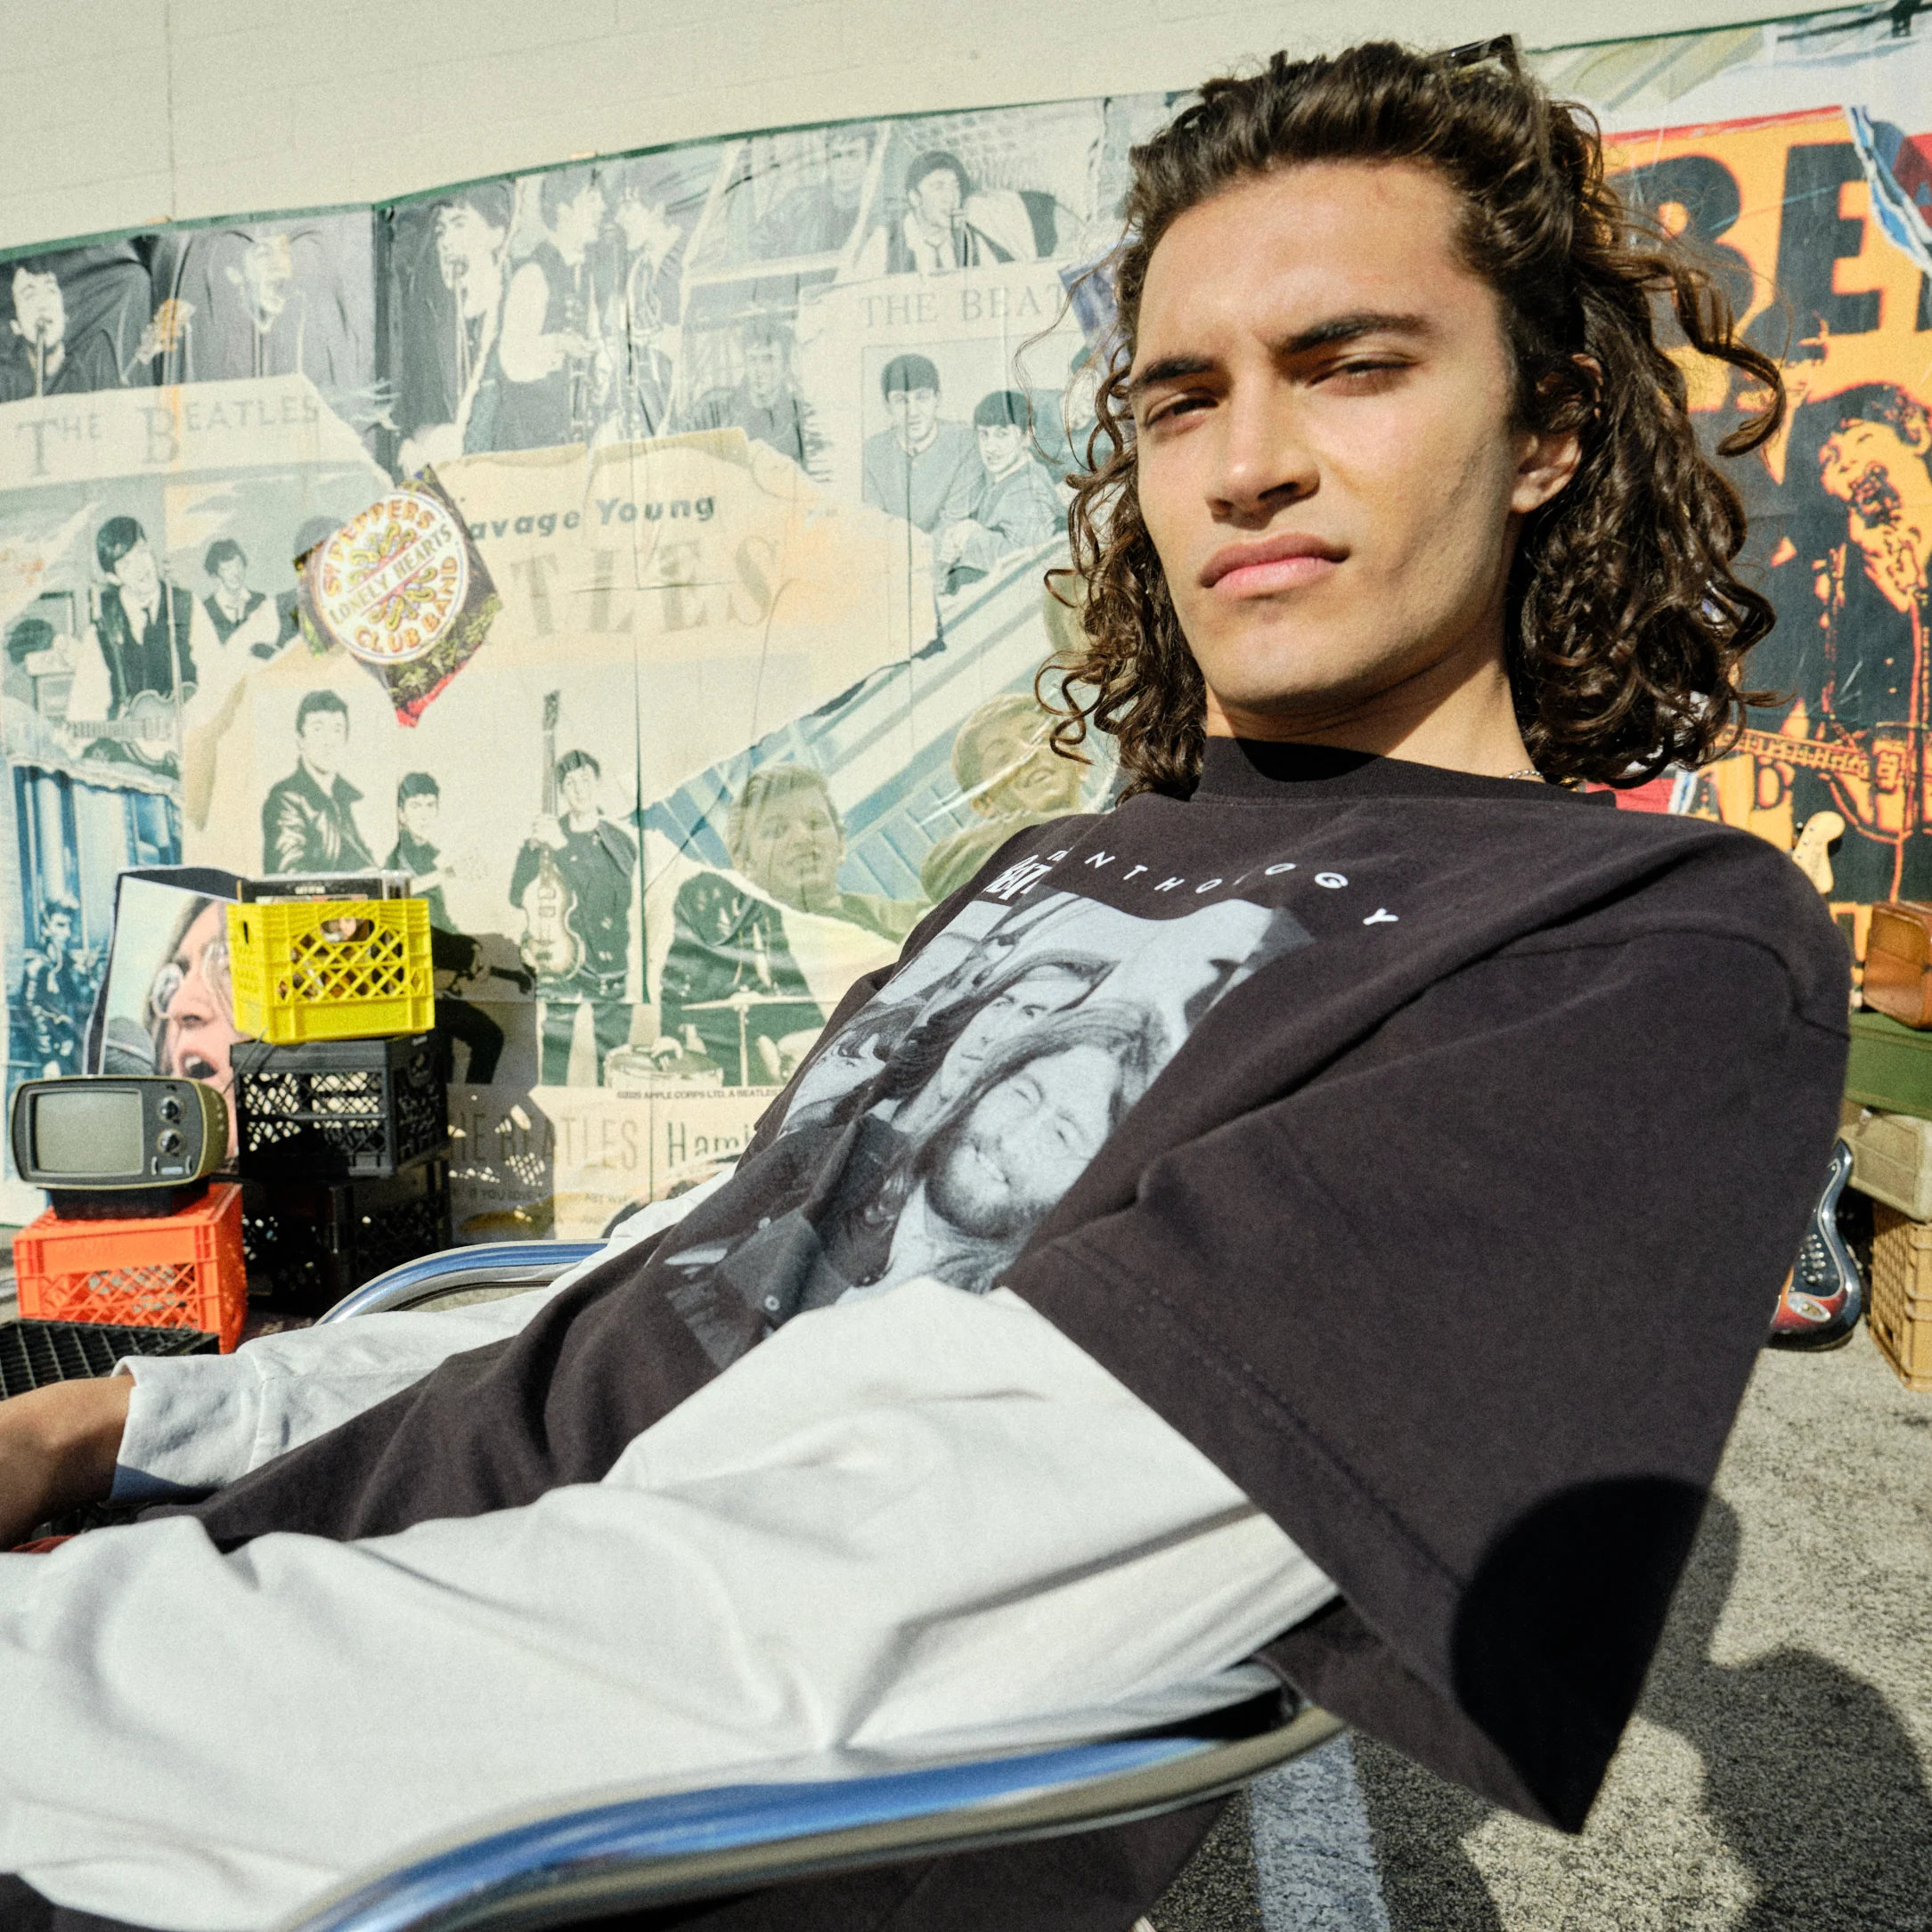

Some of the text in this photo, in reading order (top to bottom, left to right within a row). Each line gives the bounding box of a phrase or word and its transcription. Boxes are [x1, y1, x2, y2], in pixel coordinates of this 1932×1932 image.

[1596, 138, 1932, 349] BE
[860, 292, 937, 328] THE
[17, 395, 319, 476] THE BEATLES
[329, 500, 435, 562] PEPPERS
[469, 495, 715, 540] avage Young
[329, 524, 452, 624] LONELY HEARTS
[355, 556, 458, 653] CLUB BAND
[643, 1090, 673, 1099] APPLE
[674, 1090, 705, 1098] CORPS
[450, 1113, 486, 1161] HE
